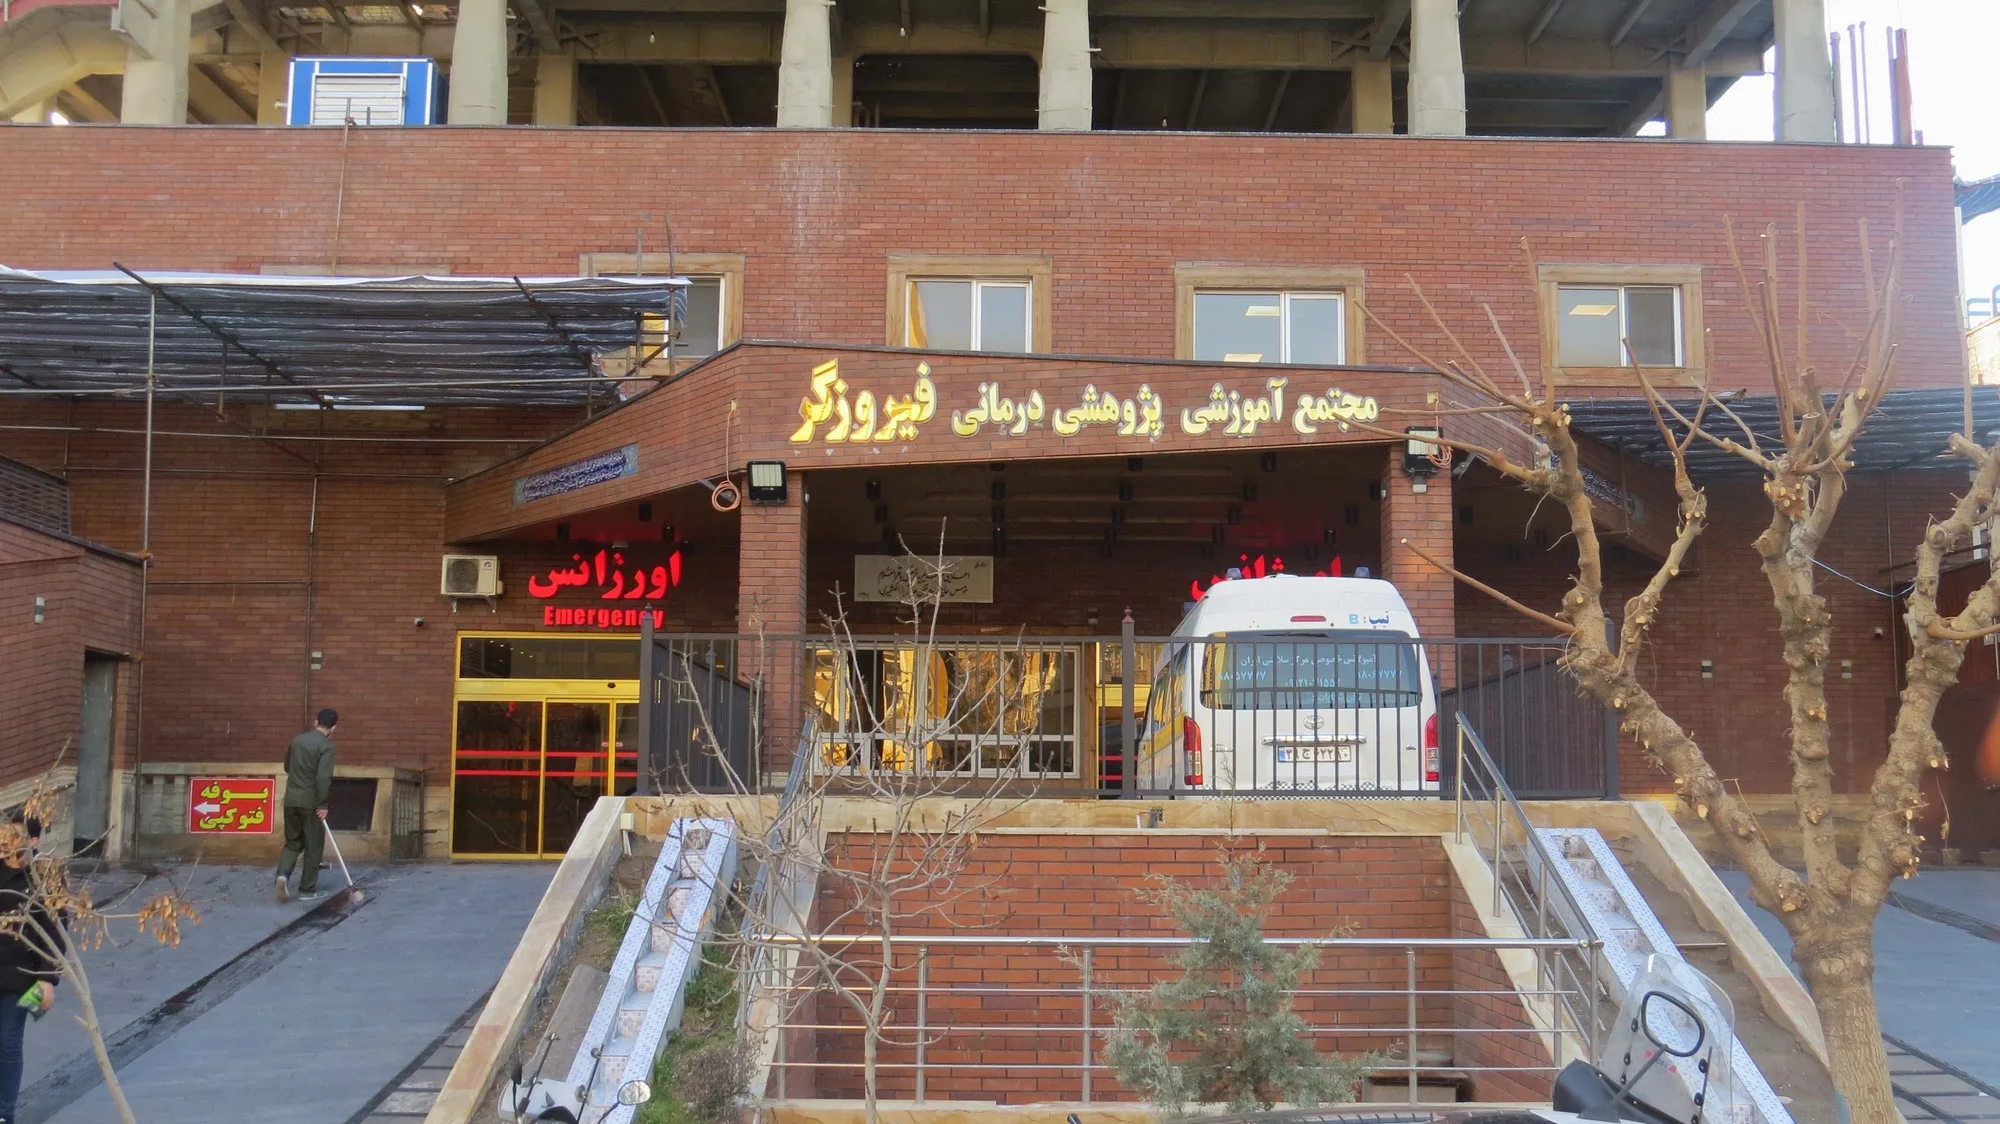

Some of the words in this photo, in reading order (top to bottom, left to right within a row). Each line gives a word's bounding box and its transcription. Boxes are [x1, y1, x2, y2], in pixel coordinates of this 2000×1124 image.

[790, 358, 936, 443] فیروزگر
[952, 382, 1044, 436] درمانی
[1053, 383, 1163, 437] پژوهشی
[1182, 377, 1288, 434] آموزشی
[1294, 388, 1377, 433] مجتمع
[528, 549, 682, 599] اورژانس
[1349, 614, 1359, 624] B
[1240, 656, 1260, 666] اران
[1262, 655, 1288, 666] سلاتی
[1344, 654, 1376, 665] آمبولنس
[200, 781, 269, 804] بوفه
